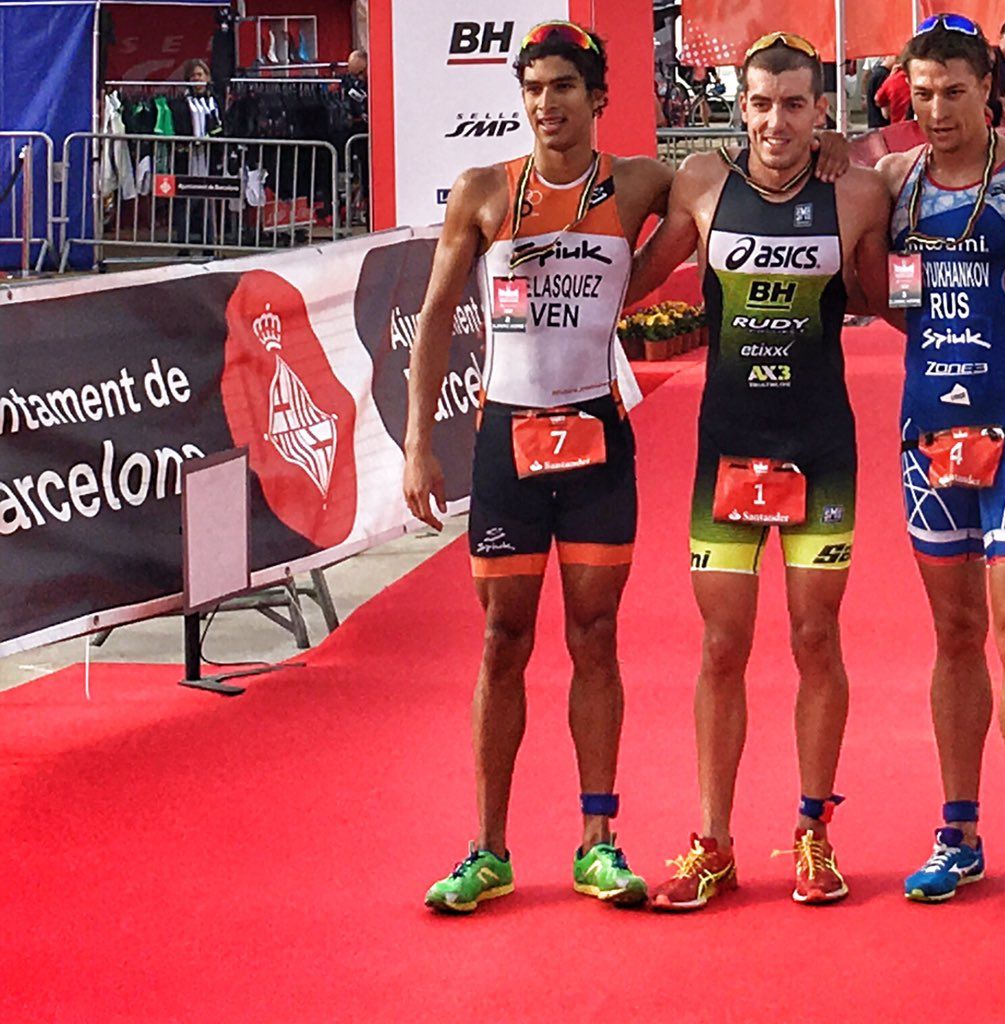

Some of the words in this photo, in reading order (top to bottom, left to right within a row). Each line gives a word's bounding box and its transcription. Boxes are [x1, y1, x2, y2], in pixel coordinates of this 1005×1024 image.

[450, 21, 514, 54] BH
[457, 112, 519, 120] SELLE
[445, 120, 520, 138] SMP
[527, 274, 602, 298] LASQUEZ
[923, 261, 989, 288] YUKHANKOV
[749, 280, 797, 303] BH
[530, 302, 580, 327] VEN
[930, 292, 970, 320] RUS
[733, 317, 810, 330] RUDY
[921, 328, 991, 349] Spiuk
[144, 358, 191, 408] de
[748, 365, 791, 381] AX3
[550, 430, 567, 455] 7
[950, 442, 963, 465] 4
[543, 457, 591, 470] Santander
[0, 439, 206, 535] arcelon
[753, 483, 766, 505] 1
[743, 511, 790, 523] Santander
